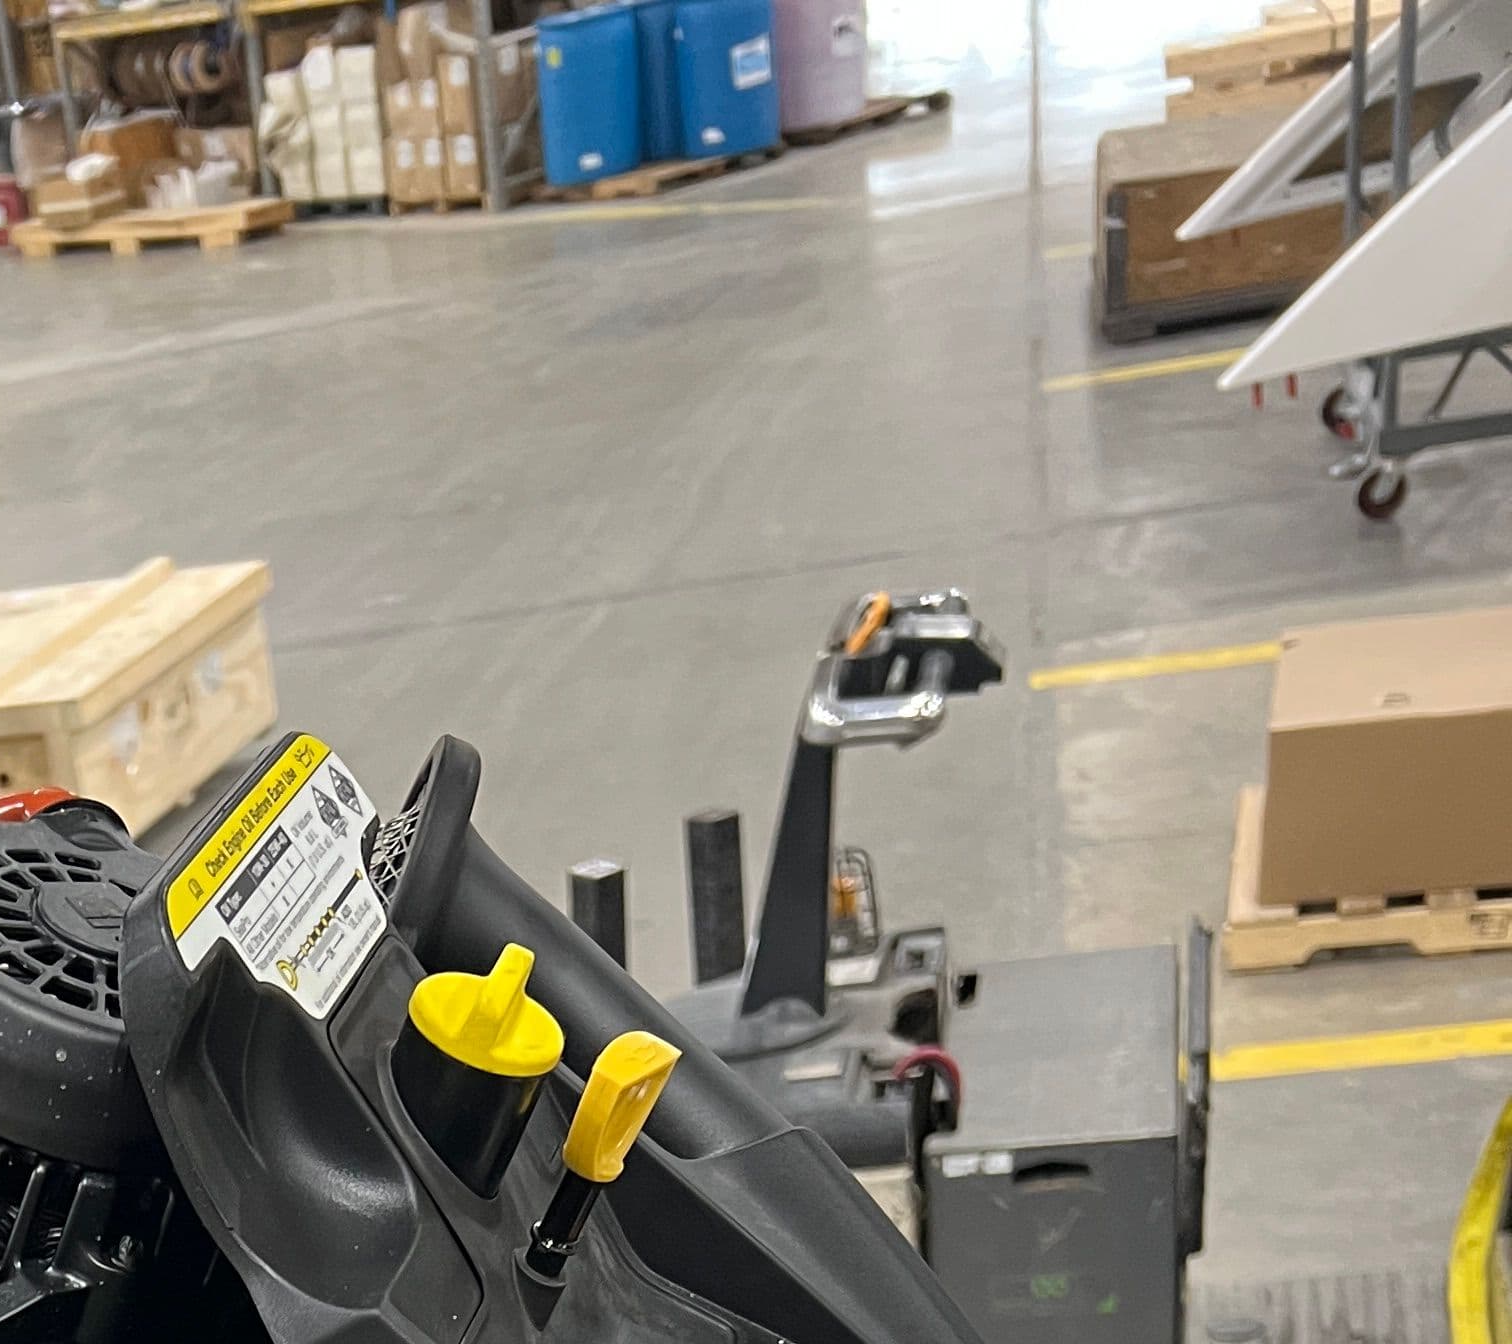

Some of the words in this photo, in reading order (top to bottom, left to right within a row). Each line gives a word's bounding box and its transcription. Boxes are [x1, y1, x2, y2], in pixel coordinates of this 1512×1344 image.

[205, 848, 227, 876] Check
[223, 825, 248, 857] Engine
[240, 814, 254, 833] Oil
[249, 794, 271, 822] Before
[267, 777, 286, 801] Each
[281, 765, 296, 785] Use
